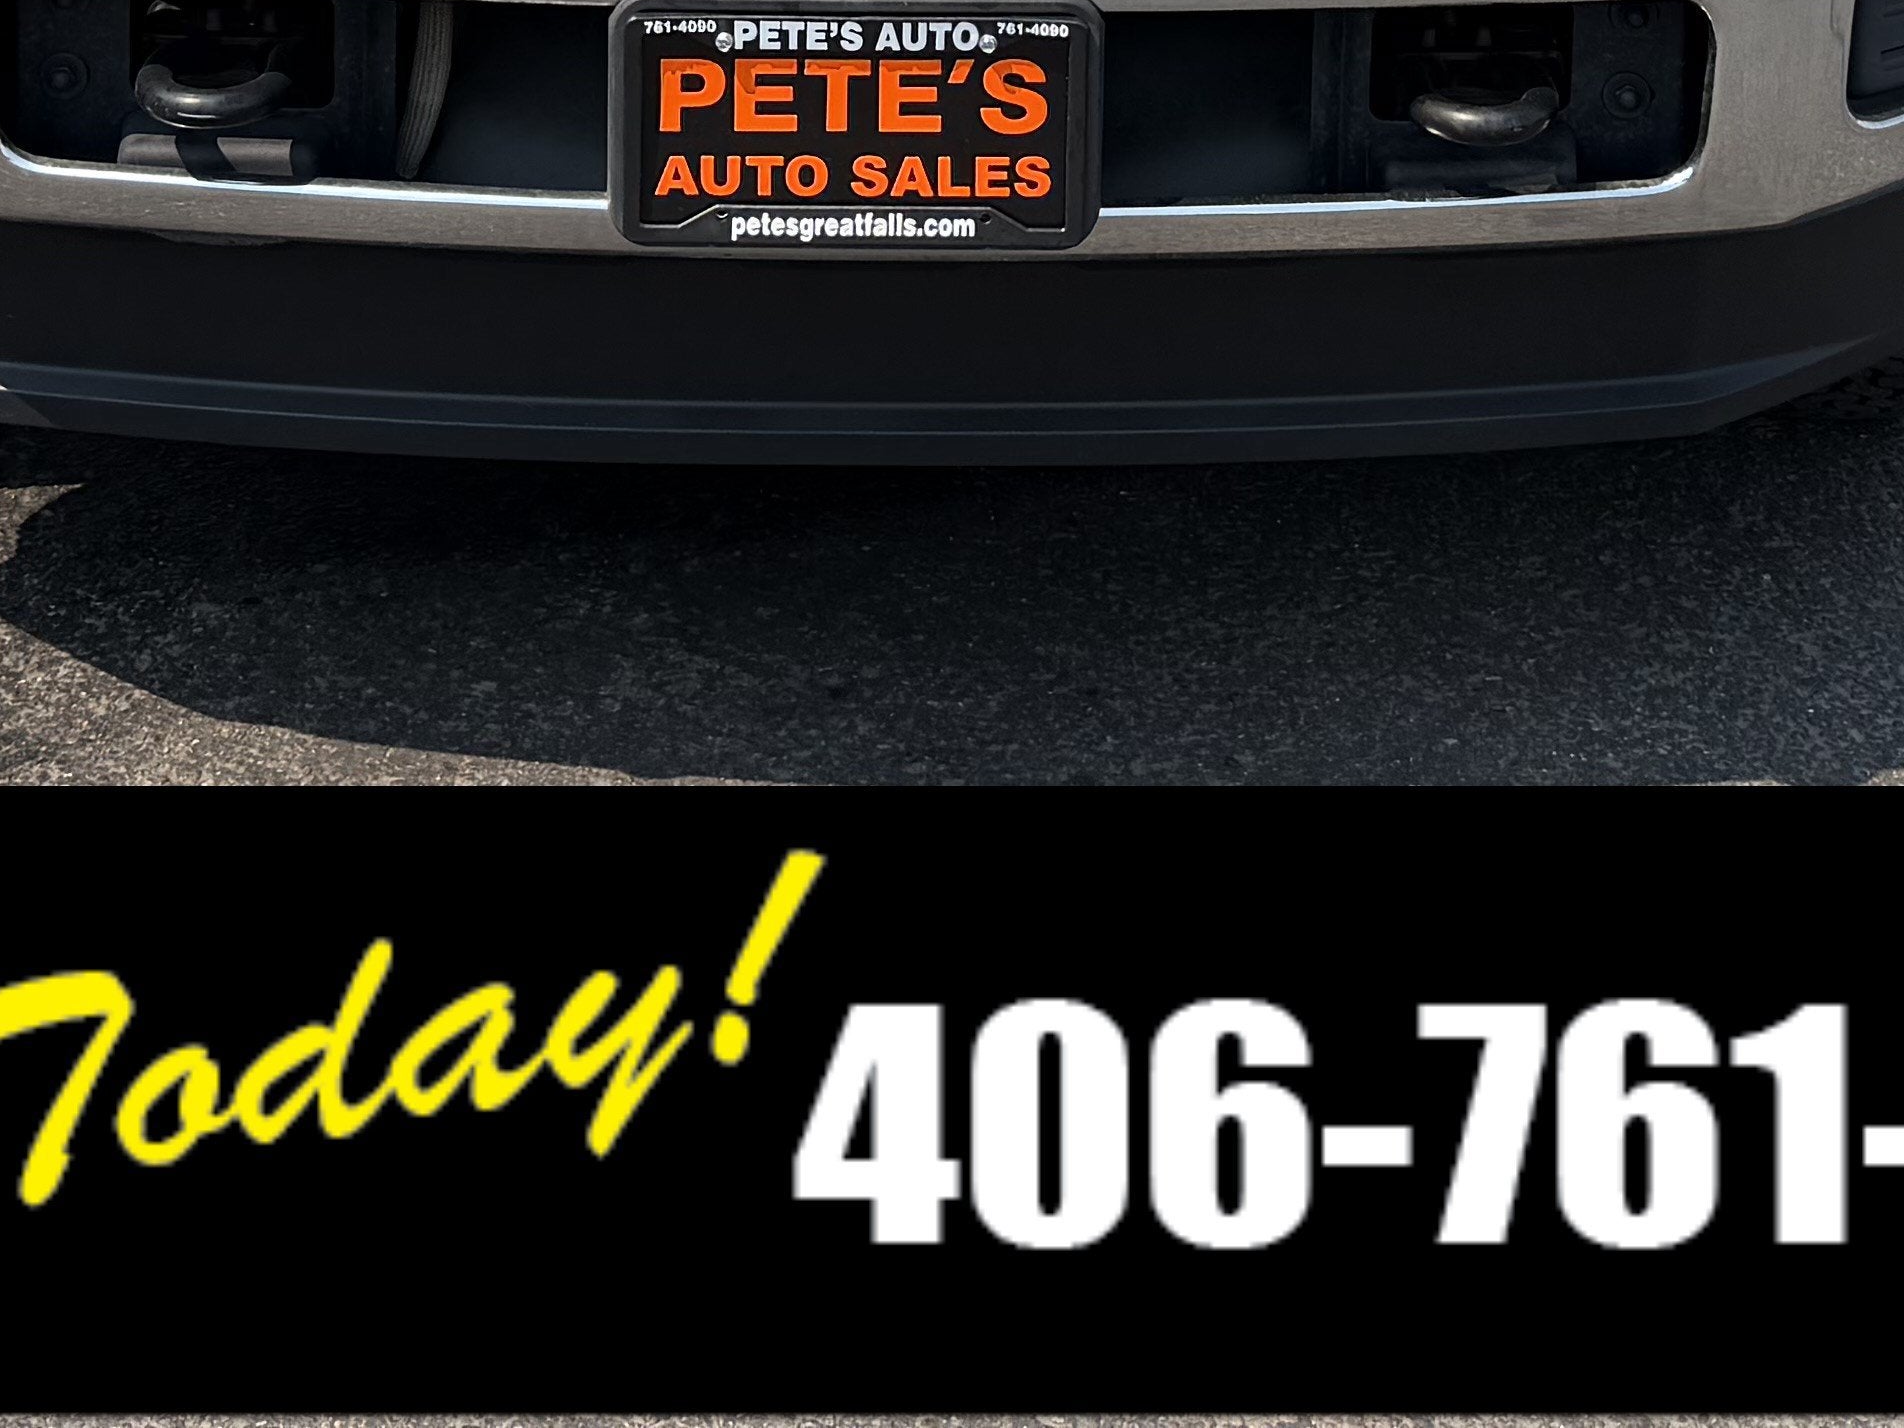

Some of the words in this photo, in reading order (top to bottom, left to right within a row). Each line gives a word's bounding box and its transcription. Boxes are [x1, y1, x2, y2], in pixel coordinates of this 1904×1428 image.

[733, 20, 864, 52] PETE'S
[875, 21, 980, 52] AUTO
[659, 58, 1049, 135] PETE'S
[655, 155, 829, 197] AUTO
[851, 155, 1052, 198] SALES
[730, 211, 977, 242] petesgreatfalls.com
